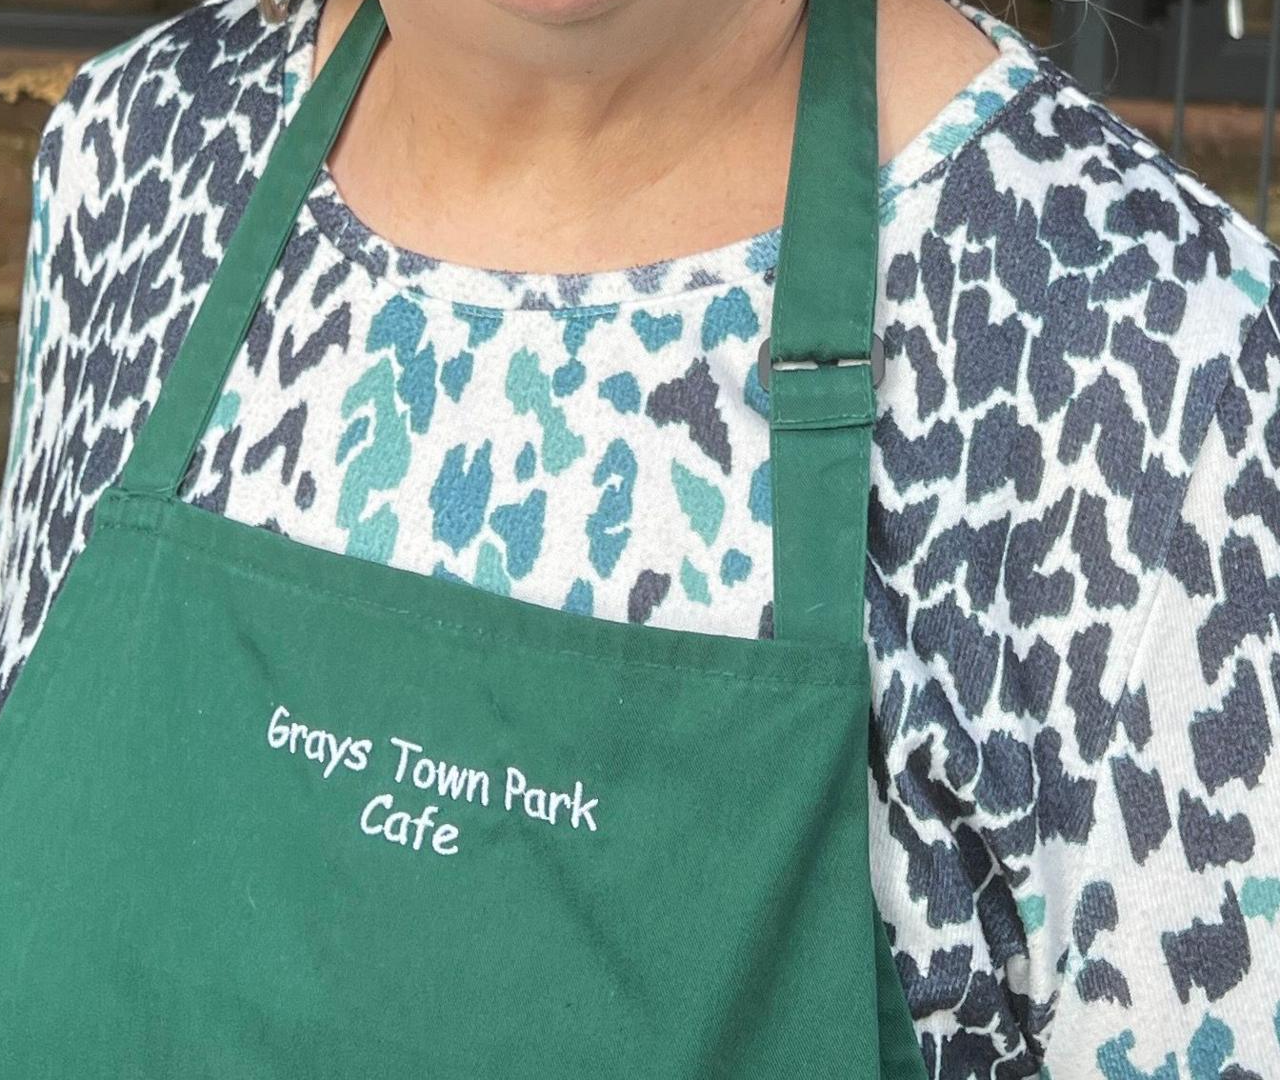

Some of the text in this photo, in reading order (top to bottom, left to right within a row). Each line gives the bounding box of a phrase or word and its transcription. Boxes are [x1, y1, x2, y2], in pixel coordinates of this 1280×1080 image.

[267, 705, 599, 831] Grays Town Park
[360, 793, 459, 855] Cafe
